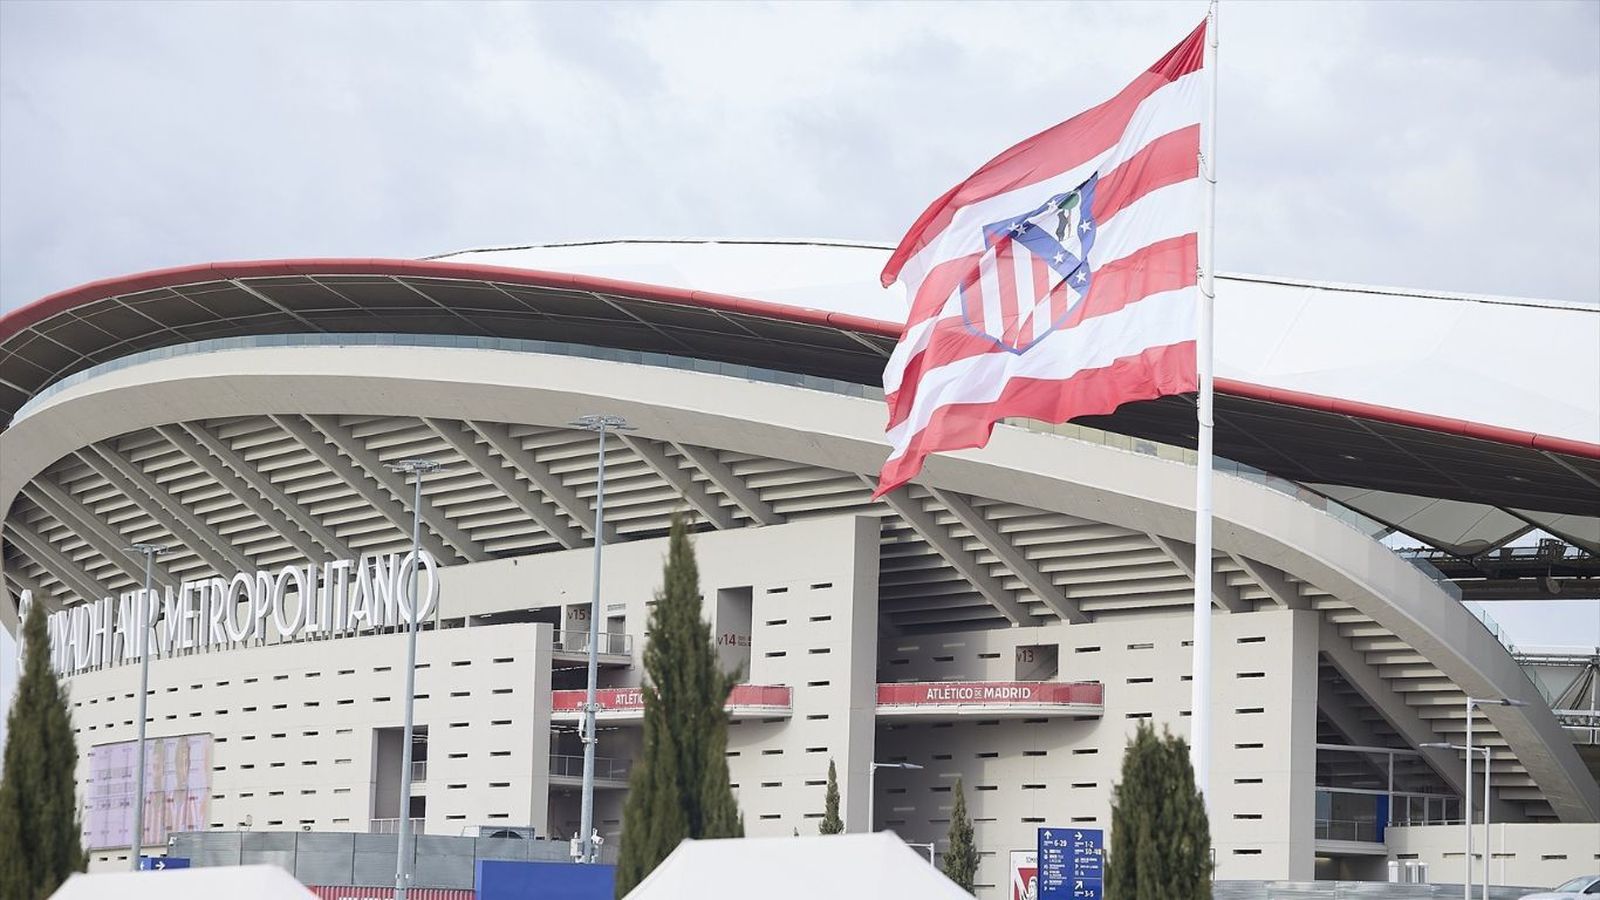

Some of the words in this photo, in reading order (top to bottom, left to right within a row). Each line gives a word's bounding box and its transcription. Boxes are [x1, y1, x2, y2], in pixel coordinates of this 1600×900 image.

[113, 588, 160, 662] AIR
[164, 550, 440, 652] METROPOLITANO
[717, 633, 737, 647] v14
[1016, 649, 1034, 663] v13
[615, 690, 644, 705] ATLÉTIC
[927, 685, 973, 699] ATLÉTICO
[974, 688, 983, 698] DE
[984, 687, 1031, 699] MADRID
